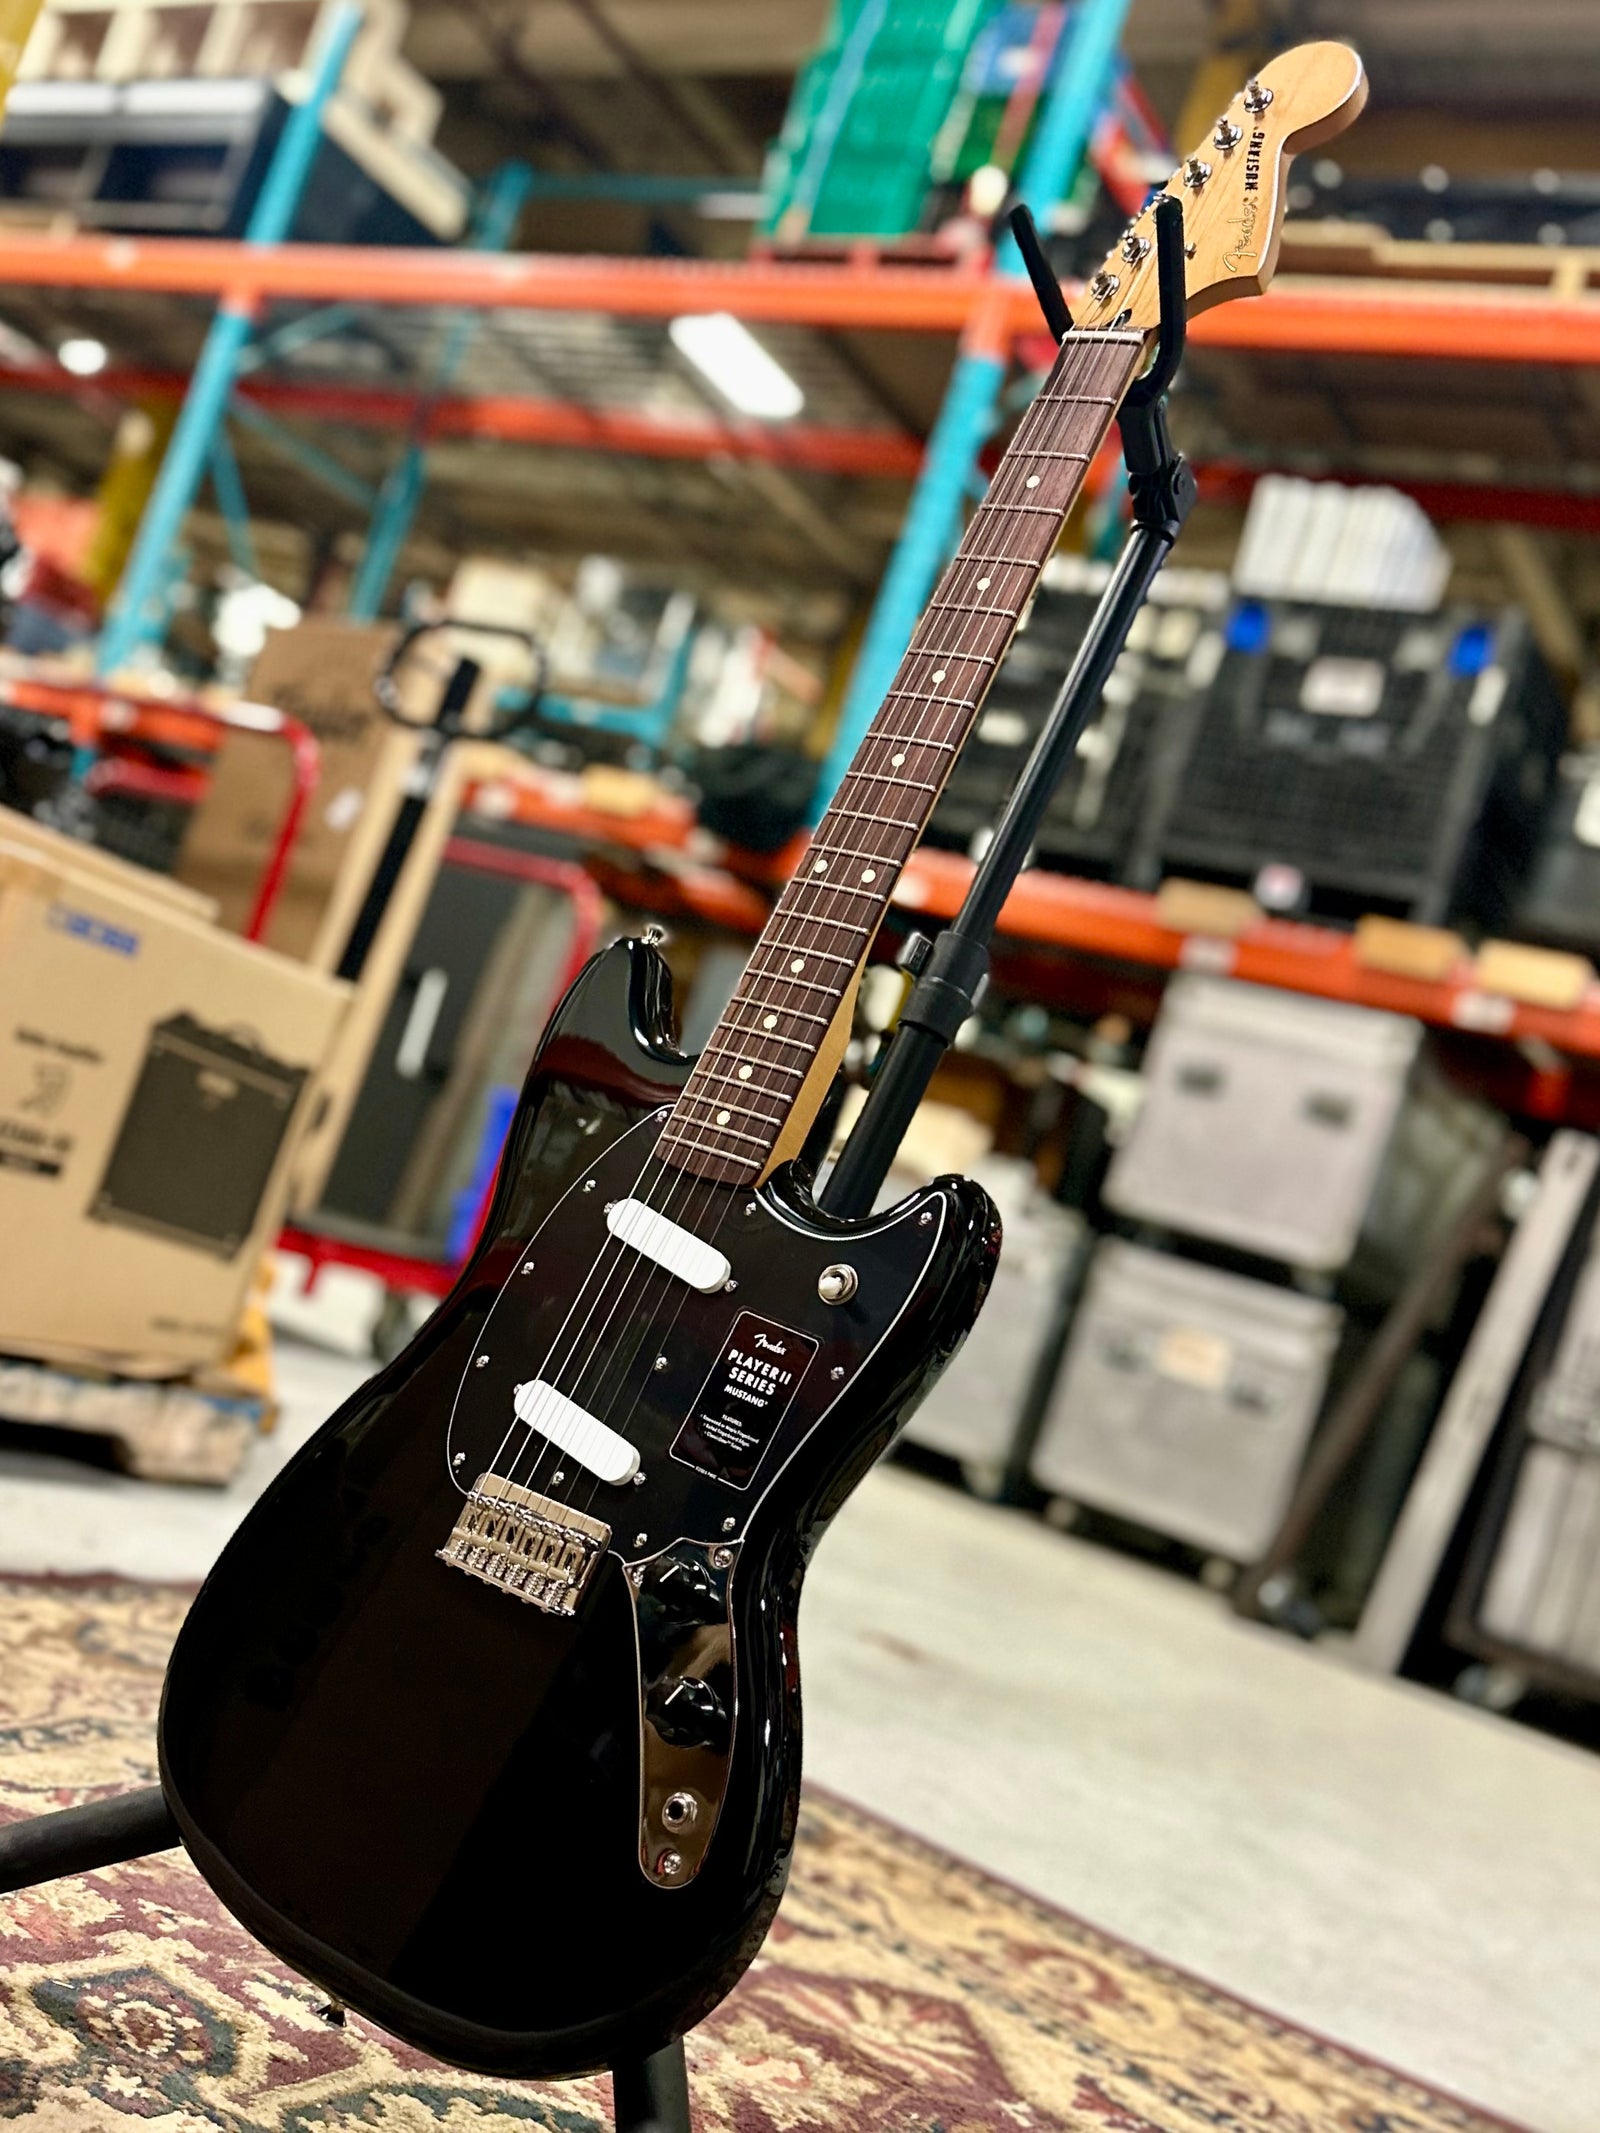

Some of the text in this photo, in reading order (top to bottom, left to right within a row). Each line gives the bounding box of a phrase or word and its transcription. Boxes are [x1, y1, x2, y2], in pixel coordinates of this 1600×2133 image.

[1223, 196, 1258, 272] Fender
[754, 1333, 787, 1356] Fender
[727, 1348, 780, 1381] PLAYER
[728, 1366, 776, 1396] SERIES
